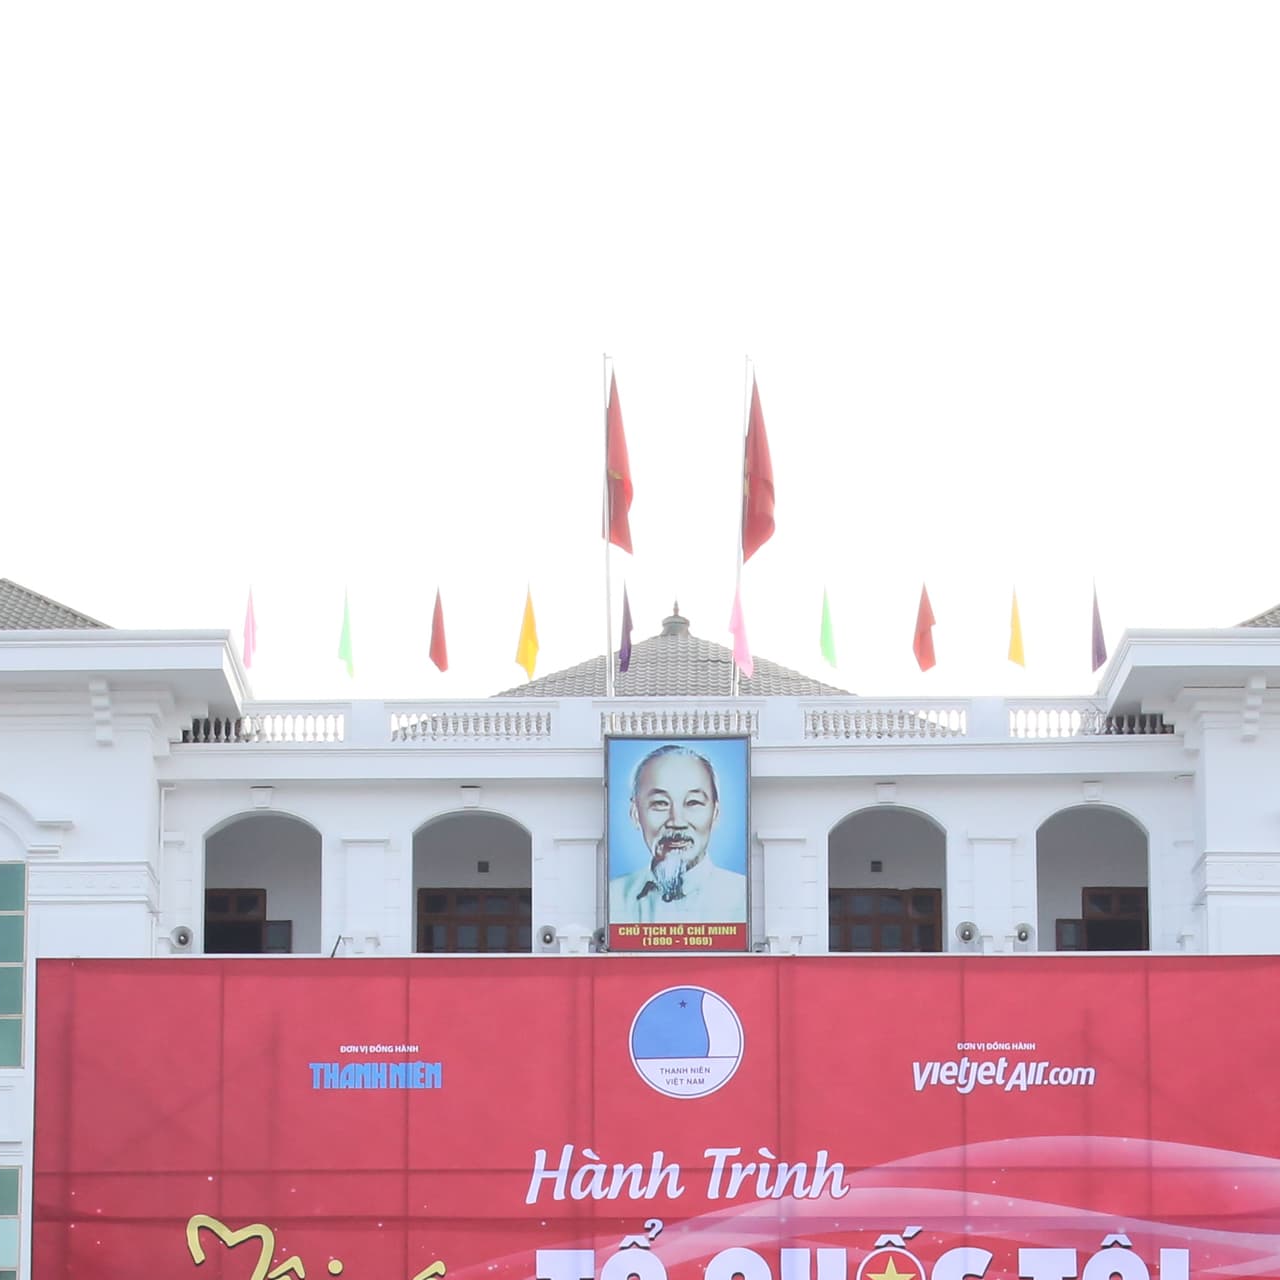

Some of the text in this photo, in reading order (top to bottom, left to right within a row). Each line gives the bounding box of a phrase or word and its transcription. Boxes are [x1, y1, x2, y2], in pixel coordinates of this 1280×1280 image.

[618, 924, 737, 937] CHỦ TỊCH HỒ CHÍ MINH
[340, 1044, 358, 1053] ĐƠN
[957, 1042, 976, 1051] ĐƠN
[660, 1065, 710, 1075] THANH NIÊN
[309, 1062, 387, 1089] THANH
[665, 1077, 705, 1086] VIỆT NAM
[525, 1143, 850, 1205] Hành Trình
